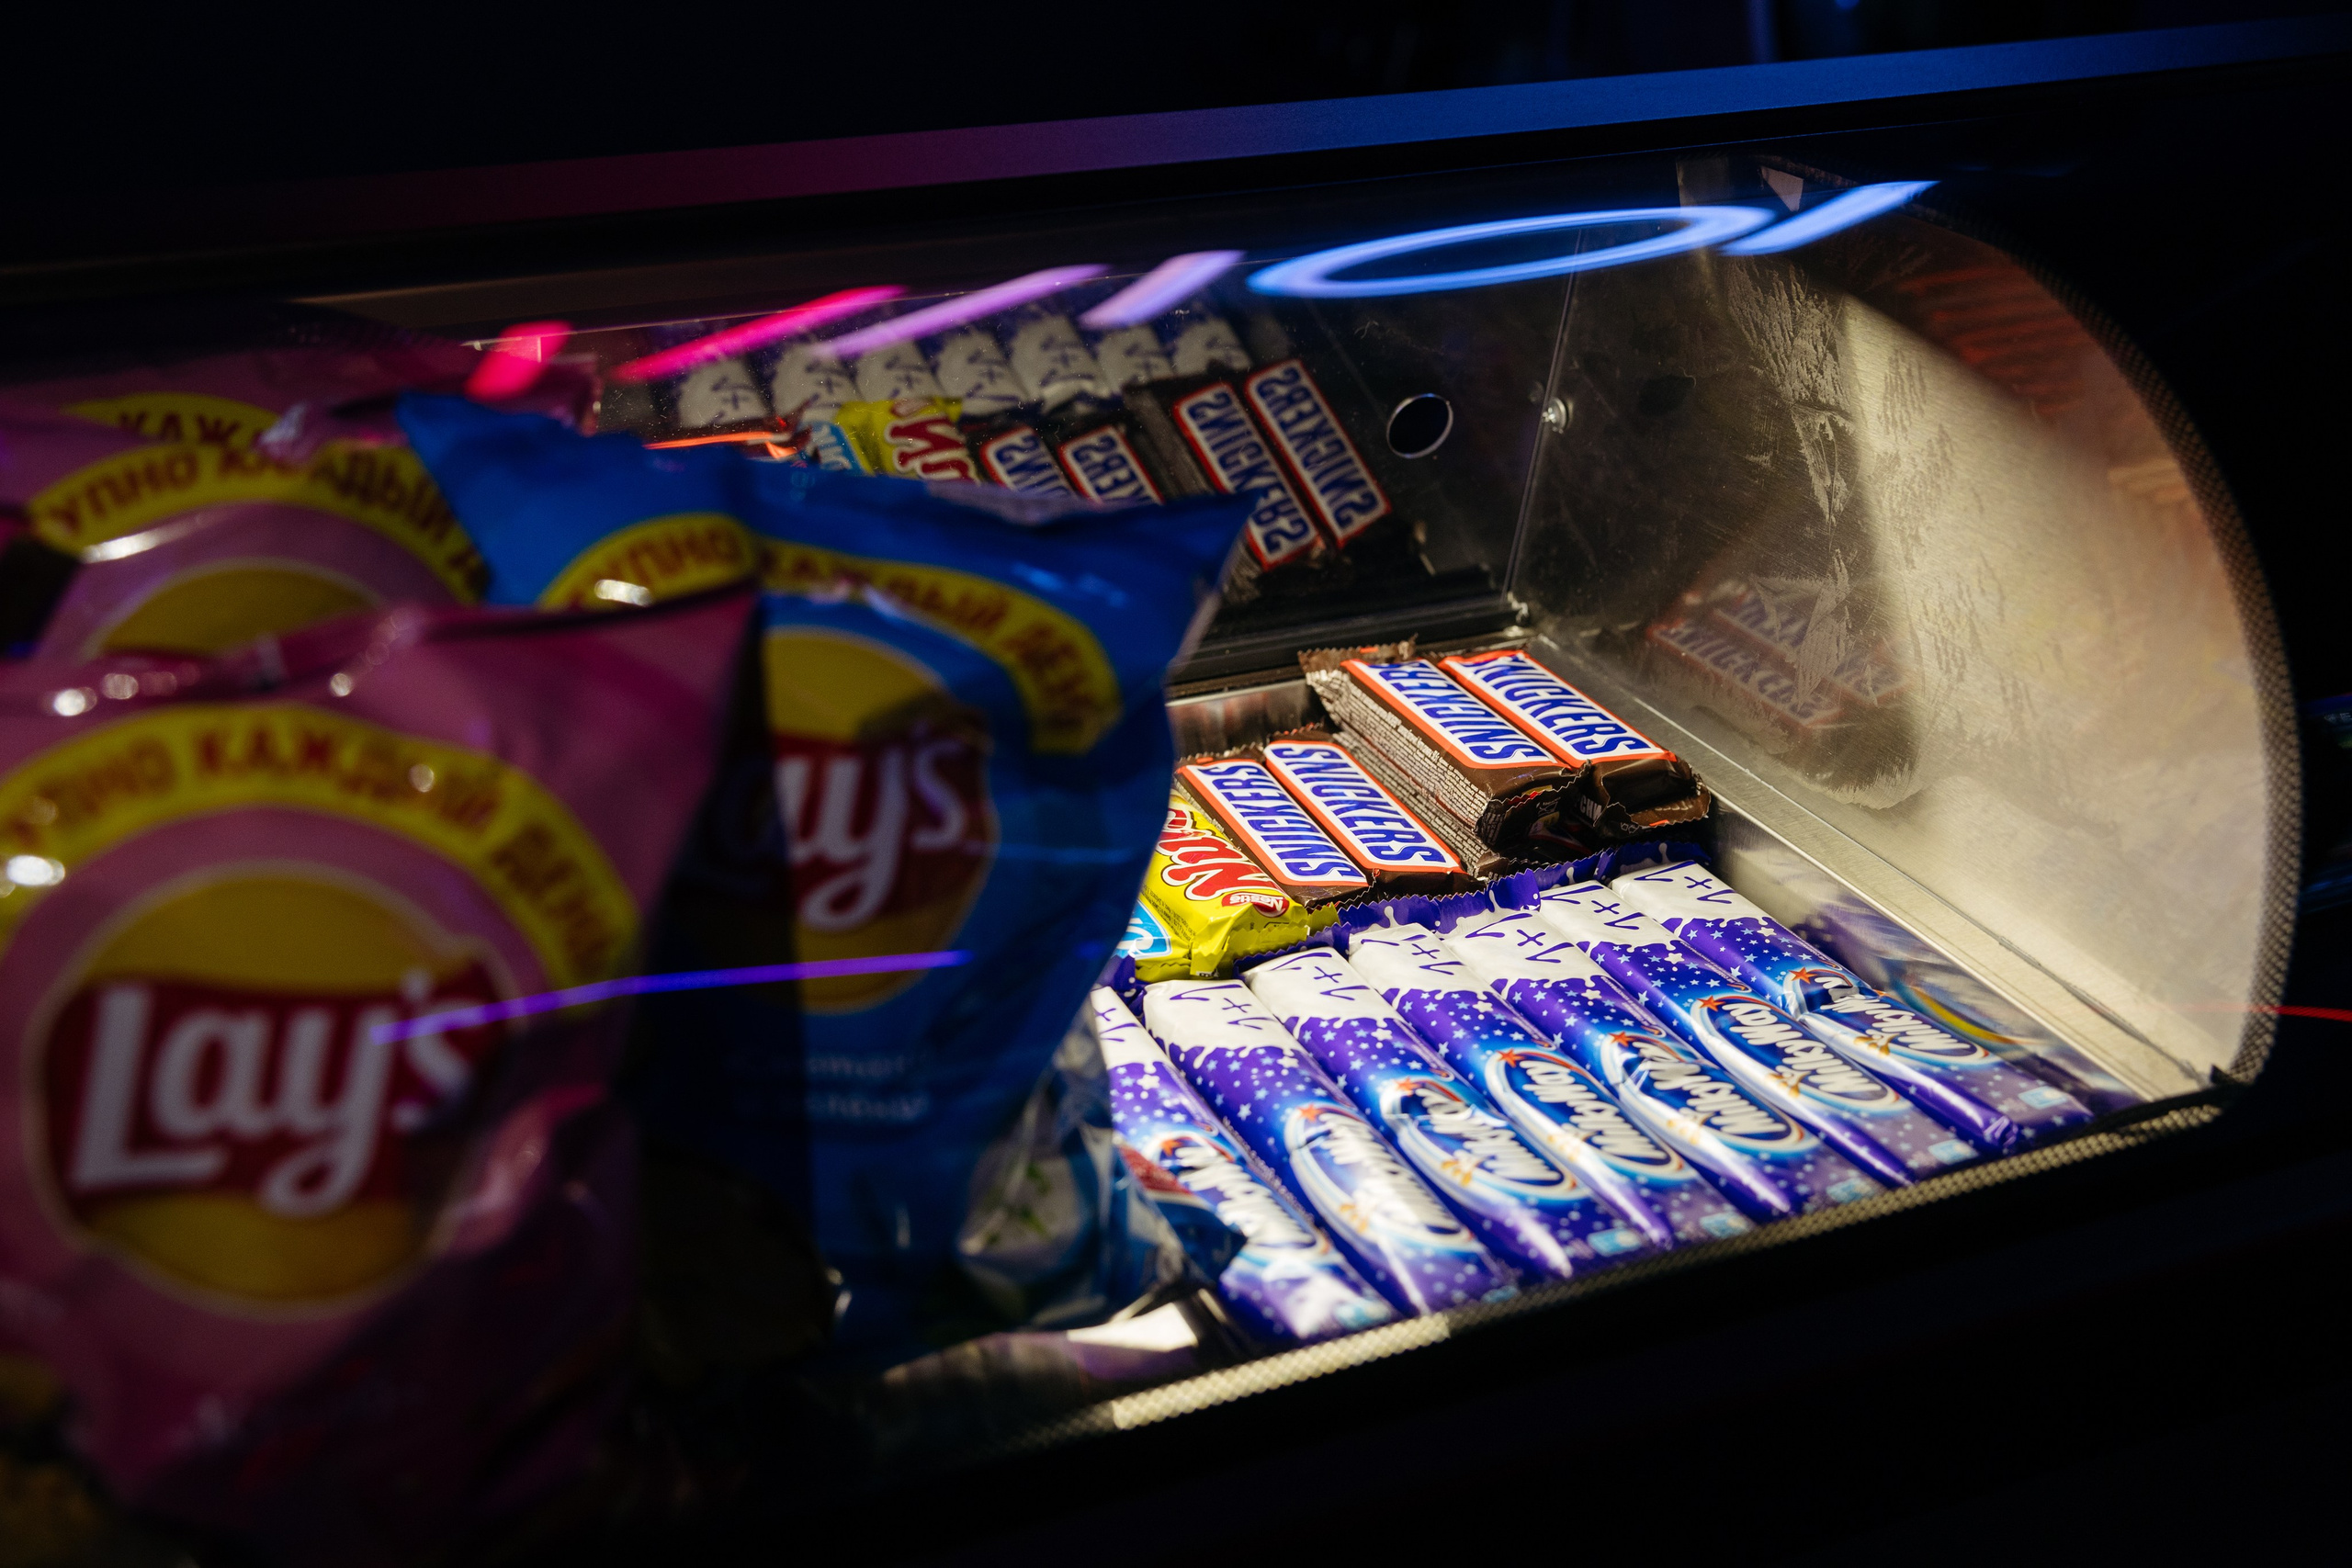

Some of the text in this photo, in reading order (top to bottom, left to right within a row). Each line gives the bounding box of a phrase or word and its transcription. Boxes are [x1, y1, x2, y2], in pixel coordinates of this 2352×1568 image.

[1199, 765, 1363, 879] SNICKERS
[1271, 746, 1447, 863] SNICKERS
[70, 968, 492, 1218] Lay's
